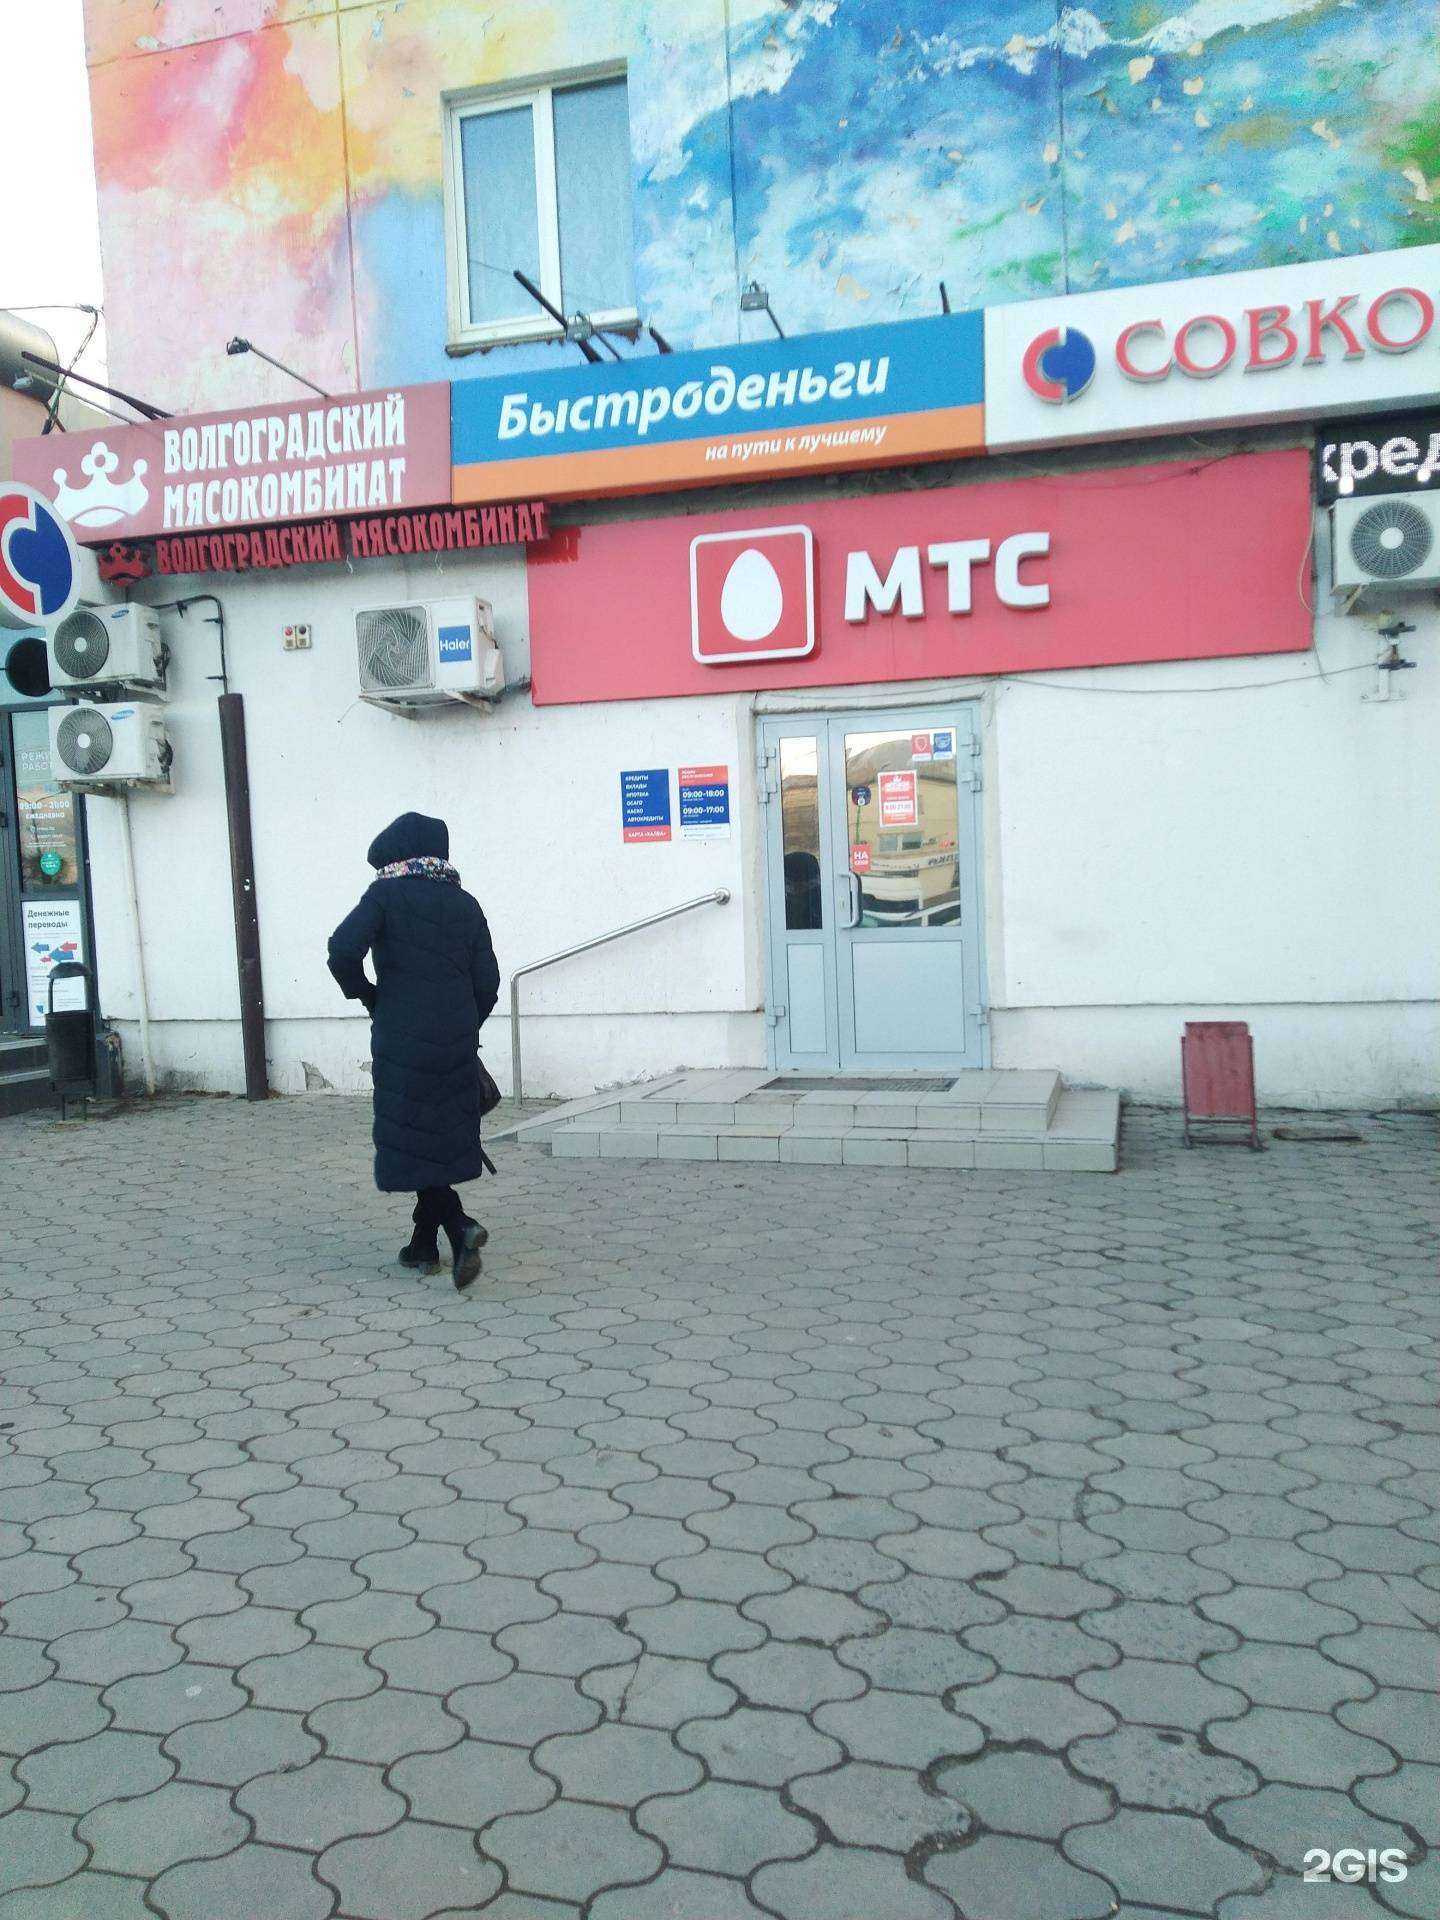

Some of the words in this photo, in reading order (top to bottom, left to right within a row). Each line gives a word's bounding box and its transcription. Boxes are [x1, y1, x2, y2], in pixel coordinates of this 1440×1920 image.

[1115, 287, 1435, 382] СОВКО
[163, 393, 406, 474] ВОЛГОГРАДСКИЙ
[497, 356, 890, 440] Быстроденьги
[705, 444, 728, 461] на
[731, 438, 782, 461] пути
[784, 436, 797, 452] к
[799, 425, 888, 452] лучшему
[162, 458, 406, 529] МЯСОКОМБИНАТ
[155, 519, 342, 574] ВОЛГОГРАДСКИЙ
[350, 503, 547, 558] МЯСОКОМБИНАТ
[844, 531, 1050, 625] МТС
[440, 638, 470, 651] Haier
[28, 909, 70, 918] Денежные
[28, 921, 68, 929] переводы
